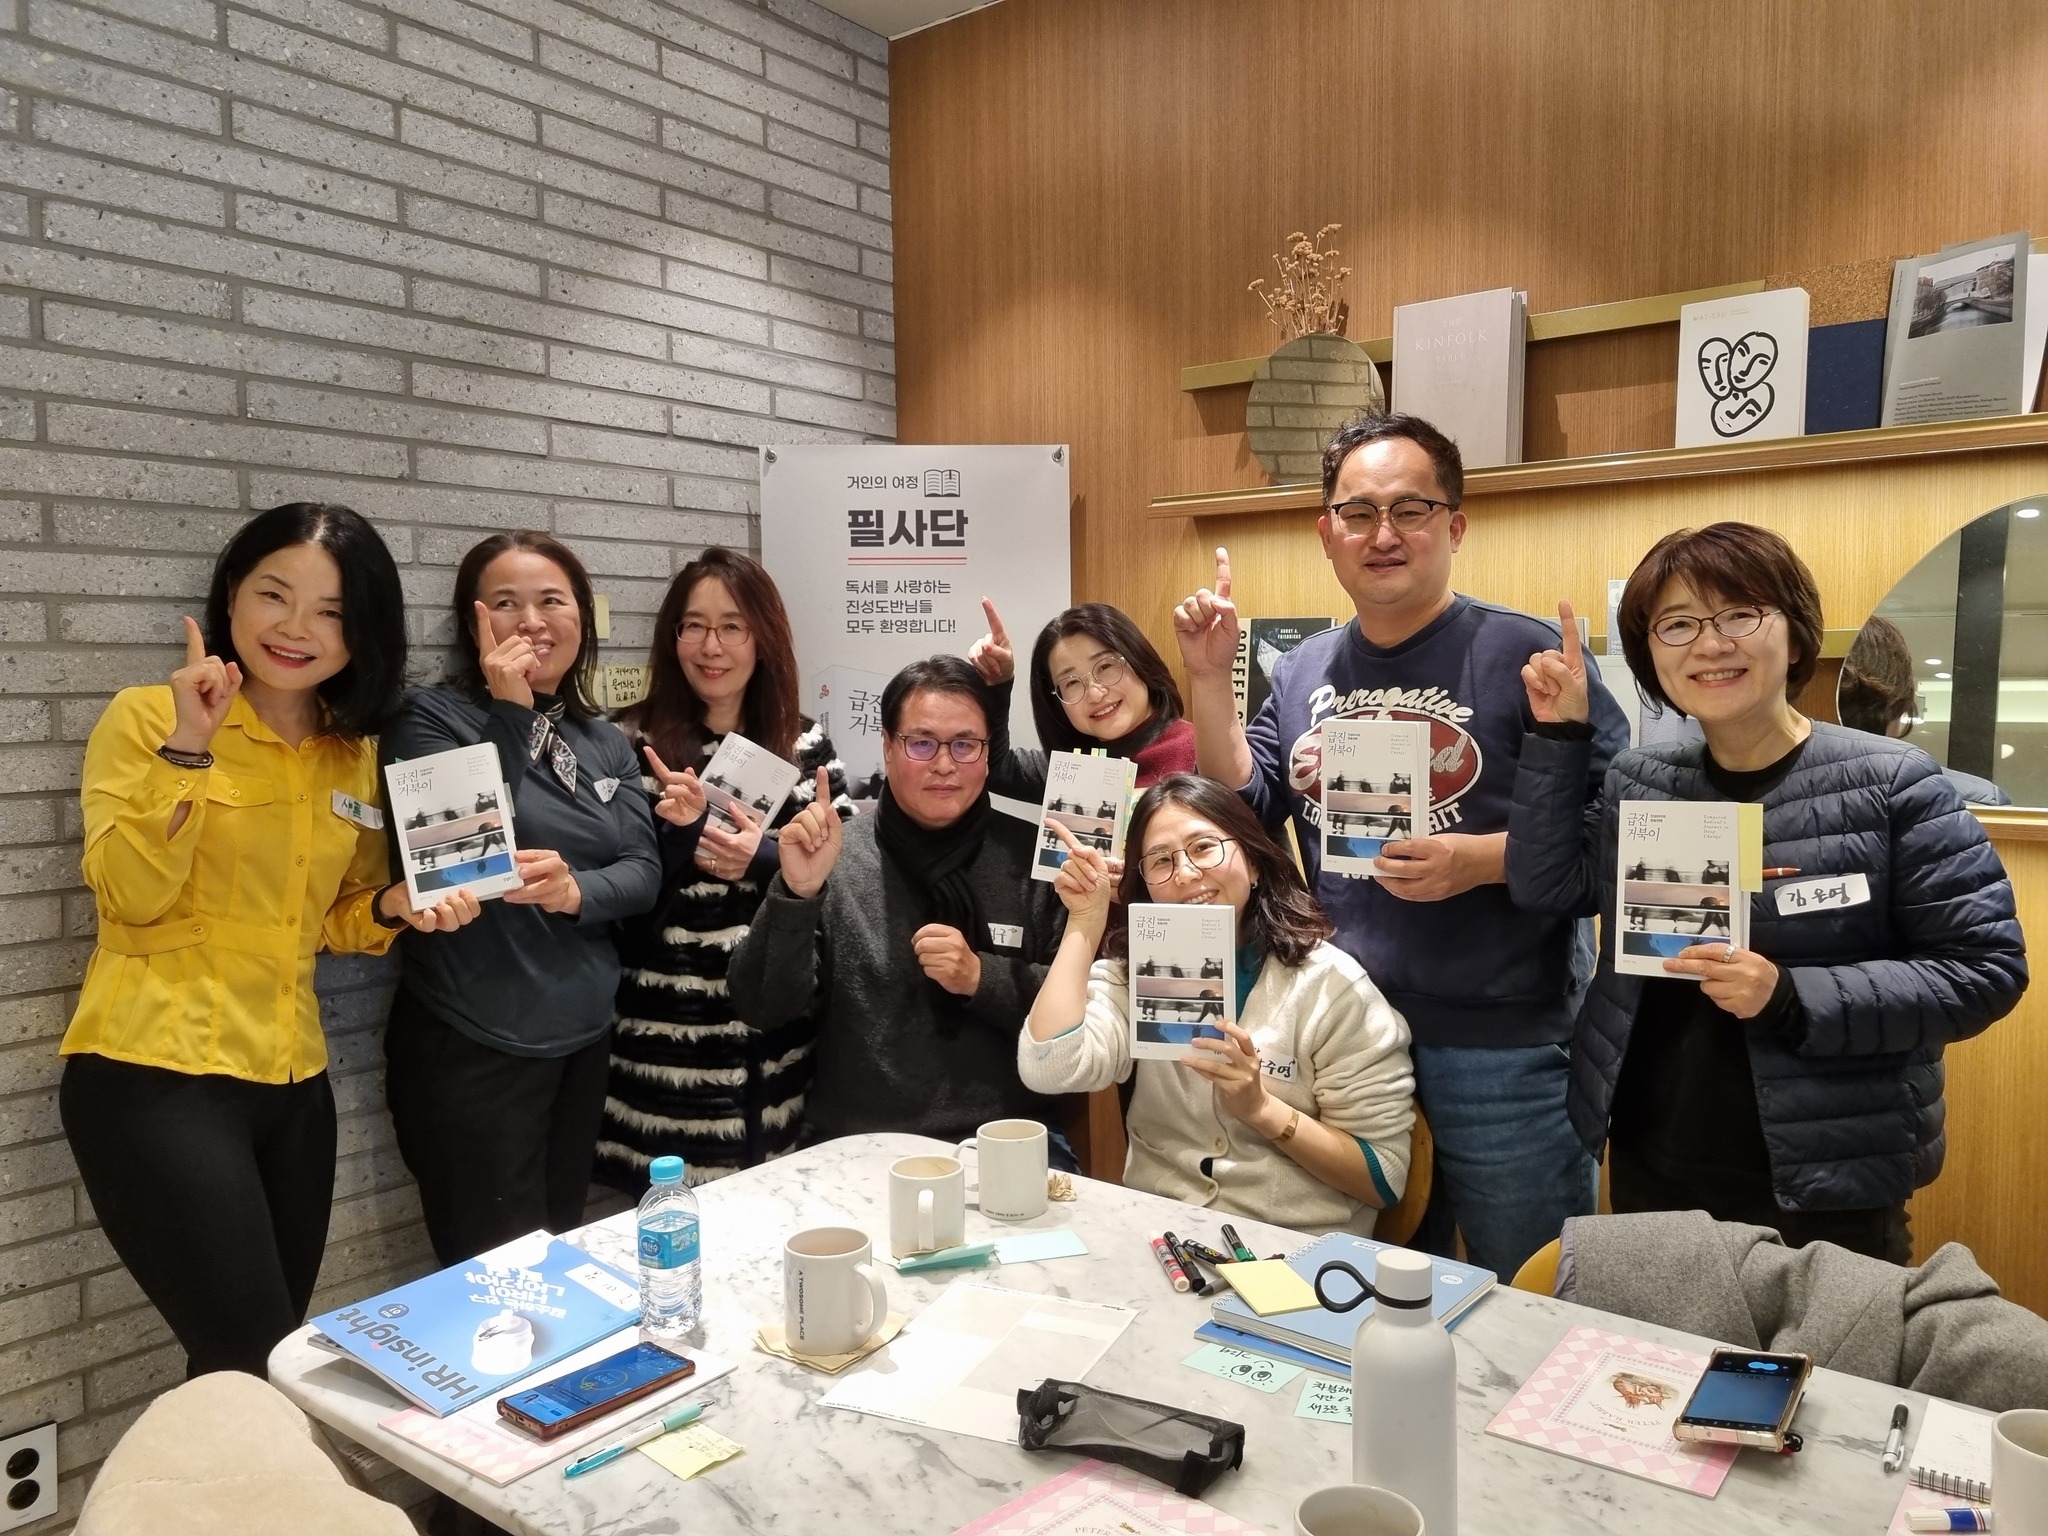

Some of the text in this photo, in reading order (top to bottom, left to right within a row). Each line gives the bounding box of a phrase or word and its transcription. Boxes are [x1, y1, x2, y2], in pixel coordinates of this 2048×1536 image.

[1415, 329, 1488, 352] KINFOLK
[847, 475, 919, 490] 거인의 여정
[847, 509, 969, 548] 필사단
[845, 579, 952, 595] 독서를 사랑하는
[846, 599, 933, 614] 진성도반님들
[846, 618, 957, 634] 모두 환영합니다!
[1308, 684, 1474, 727] Prerogative
[1327, 731, 1346, 744] 급진
[1327, 743, 1356, 757] 거북이
[395, 769, 418, 786] 급진
[398, 778, 432, 796] 거북이
[1626, 812, 1649, 827] 급진
[1626, 826, 1661, 842] 거북이
[1786, 888, 1807, 907] 김
[1136, 916, 1156, 929] 급진
[1136, 928, 1166, 942] 거북이
[464, 1271, 566, 1297] 나아가야
[488, 1285, 549, 1305] HR이
[338, 1307, 438, 1372] insight
[421, 1363, 480, 1401] HR
